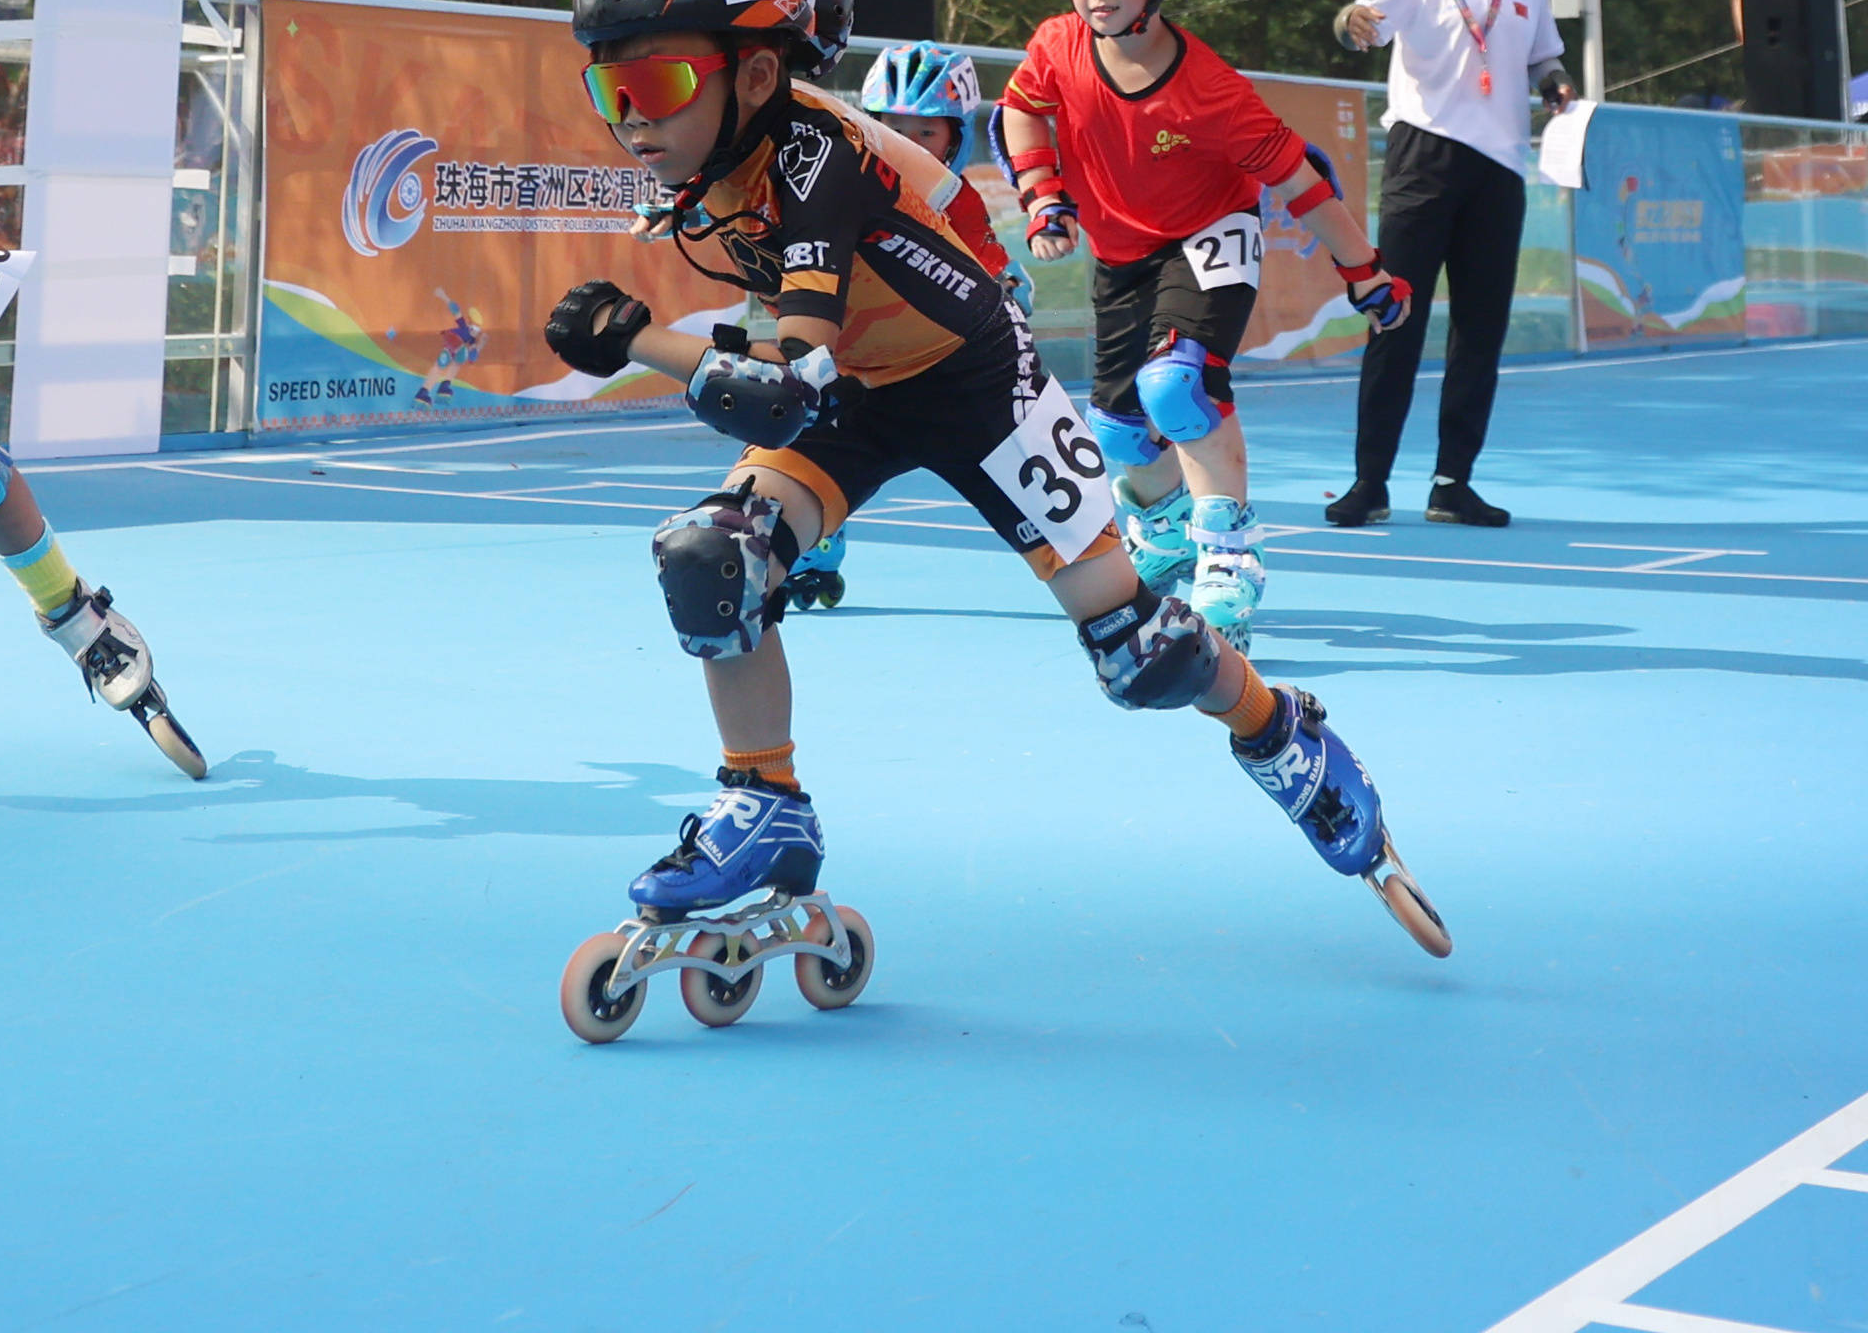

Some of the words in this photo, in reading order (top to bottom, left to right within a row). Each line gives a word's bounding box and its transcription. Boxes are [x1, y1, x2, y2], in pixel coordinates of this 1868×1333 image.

[434, 217, 470, 231] ZHUHAI
[470, 218, 525, 231] XIANGZHOU
[526, 218, 562, 231] DISTRICT
[564, 219, 593, 231] ROLLER
[594, 219, 628, 231] SKATING
[269, 379, 321, 403] SPEED
[327, 377, 396, 400] SKATING
